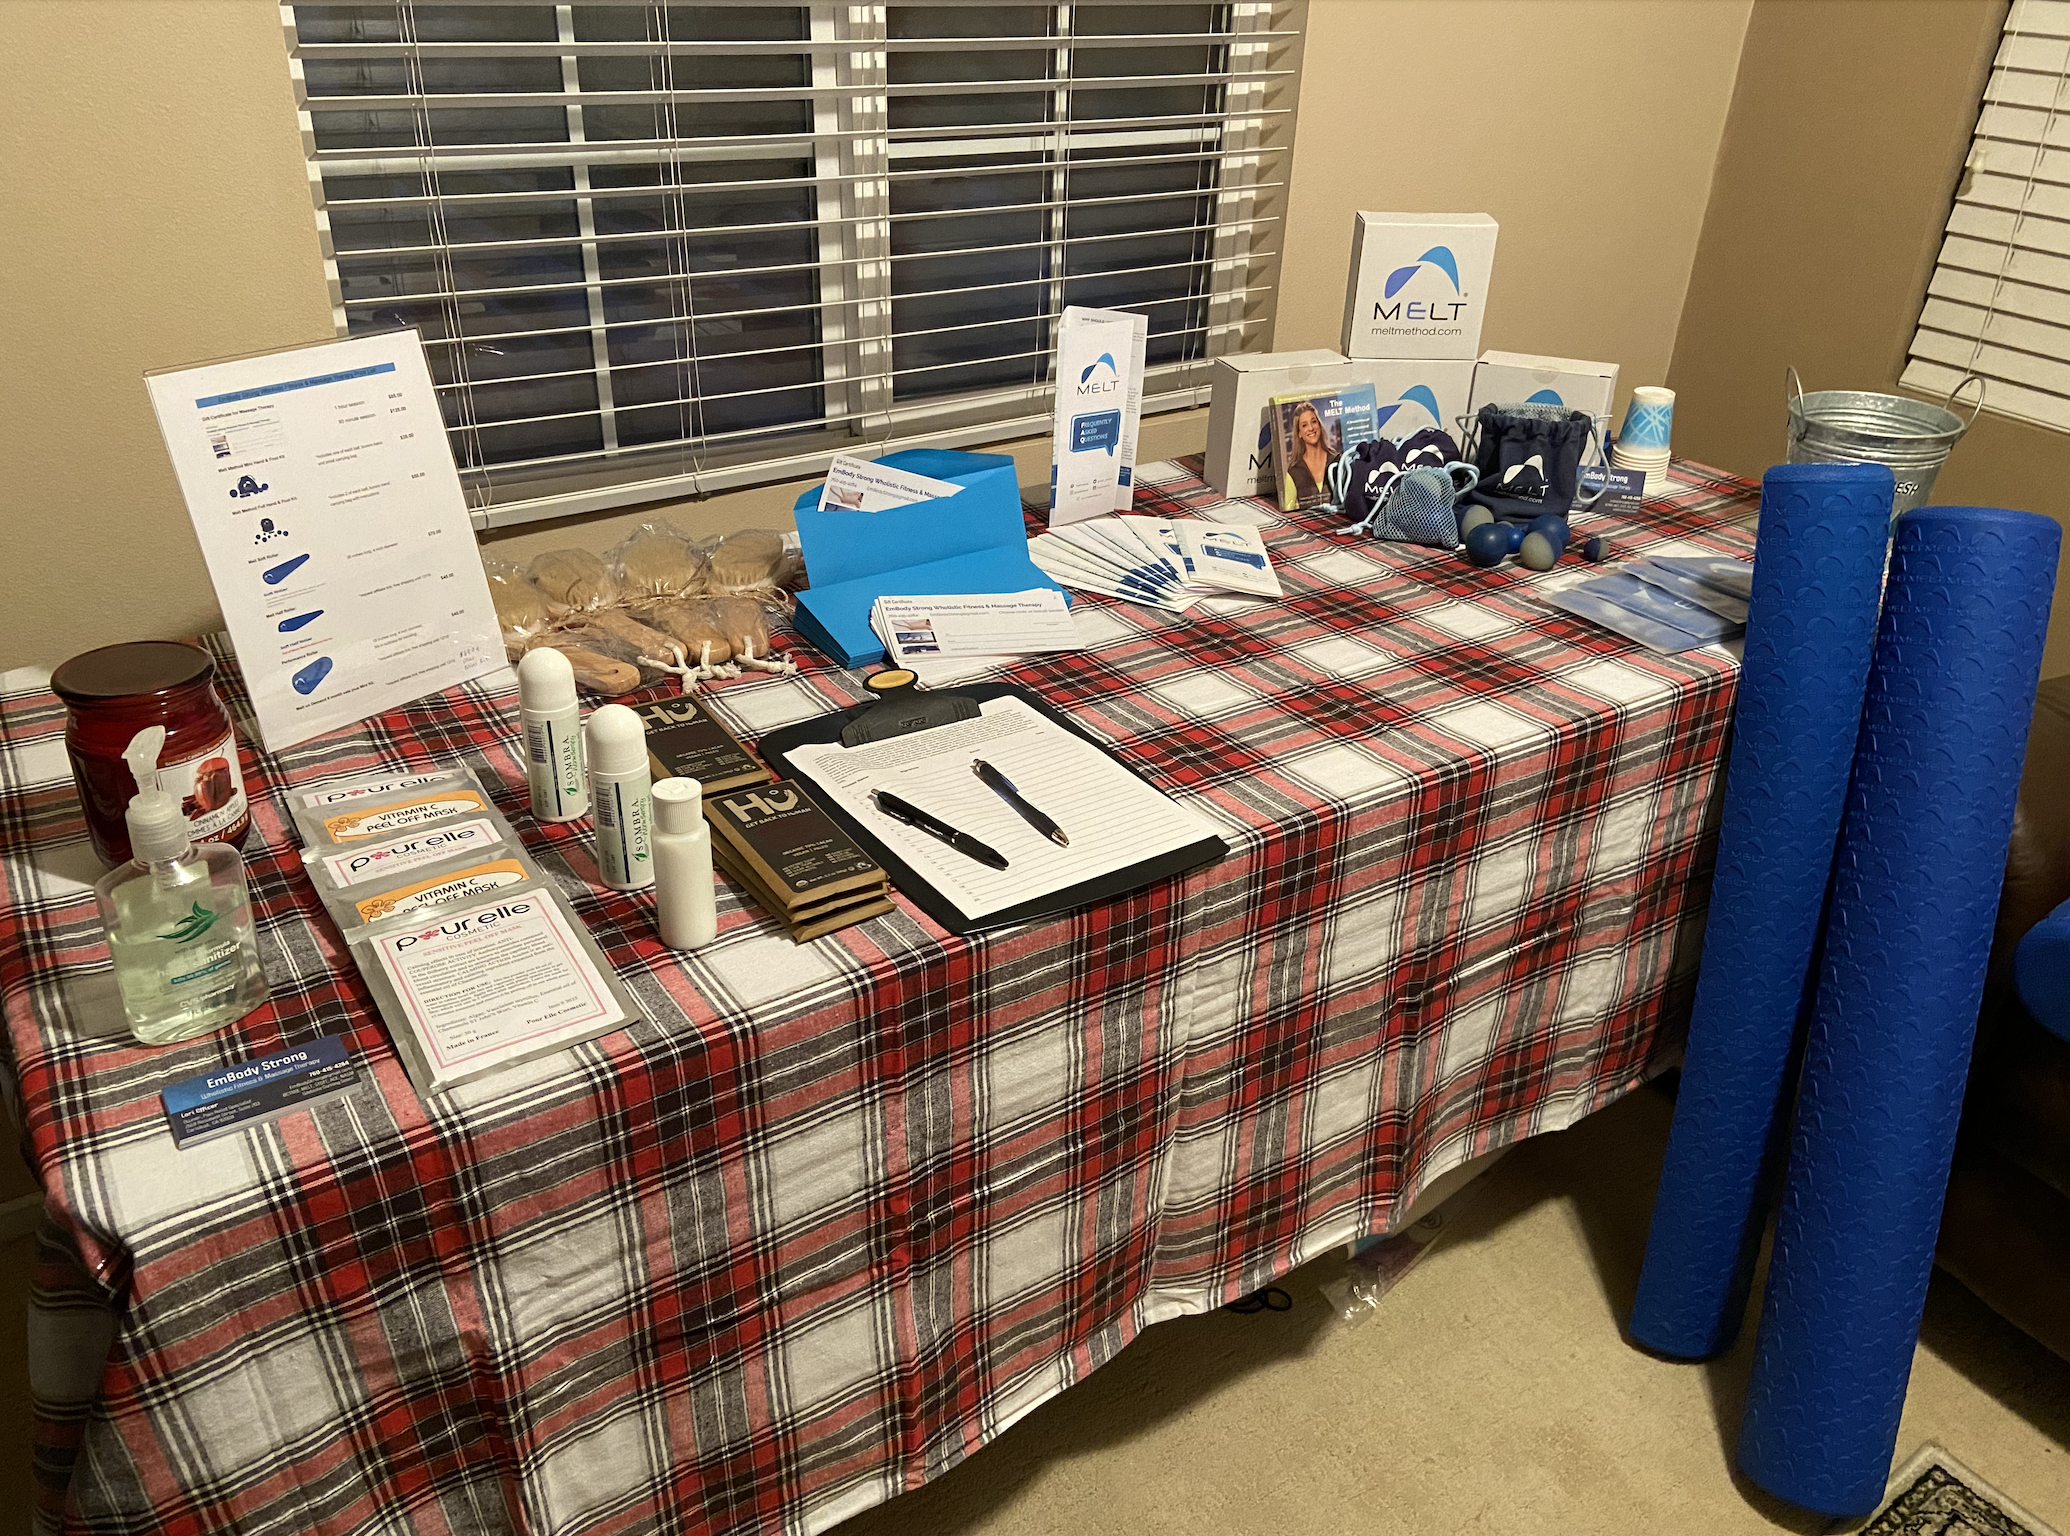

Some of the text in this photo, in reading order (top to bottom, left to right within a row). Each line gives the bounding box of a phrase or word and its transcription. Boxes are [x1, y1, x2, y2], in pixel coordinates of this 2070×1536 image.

[1373, 301, 1467, 321] MELT
[1371, 326, 1462, 336] meltmethod.com
[1076, 380, 1119, 396] MELT
[1324, 404, 1370, 417] MELT Method
[1329, 400, 1343, 408] The
[1081, 418, 1112, 428] FREQUENTLY
[1080, 433, 1108, 444] QUESTIONS
[1081, 428, 1097, 436] ASKED
[832, 467, 856, 479] EmBody
[856, 473, 874, 484] Strong
[875, 477, 899, 490] Wholistic
[900, 484, 919, 495] Fitness
[659, 724, 676, 732] BACK
[562, 735, 574, 786] SOMBRA
[194, 810, 225, 827] CINNAMON
[366, 807, 458, 832] PEEL OFF MASK
[378, 806, 428, 821] VITAMIN
[745, 820, 759, 829] GET
[759, 815, 777, 825] BACK
[187, 826, 211, 837] OMMES
[631, 798, 644, 852] SOMBRA
[426, 829, 475, 846] elle
[396, 843, 447, 859] COSMETIC
[414, 878, 479, 903] VITAMIN C
[462, 881, 499, 897] MASK
[478, 904, 531, 924] elle
[446, 921, 501, 941] COSMETIC
[422, 941, 462, 957] SENSITIVE
[462, 936, 483, 945] PEEL
[499, 924, 522, 934] MASK
[193, 941, 241, 967] sanitizer
[201, 983, 236, 1001] pharmacy
[423, 989, 461, 1005] DIRECTION
[461, 985, 475, 993] FOR
[526, 1016, 542, 1024] Pour
[543, 1011, 557, 1019] Elle
[557, 1001, 587, 1014] Cosmetic
[446, 1040, 466, 1050] Made
[474, 1028, 499, 1040] France
[206, 1050, 308, 1089] EmBody Strong
[200, 1083, 233, 1100] Wholistic
[233, 1078, 257, 1092] Fitness
[264, 1069, 294, 1081] Massage
[294, 1058, 321, 1072] Therapy
[180, 1102, 219, 1118] Lori Officer
